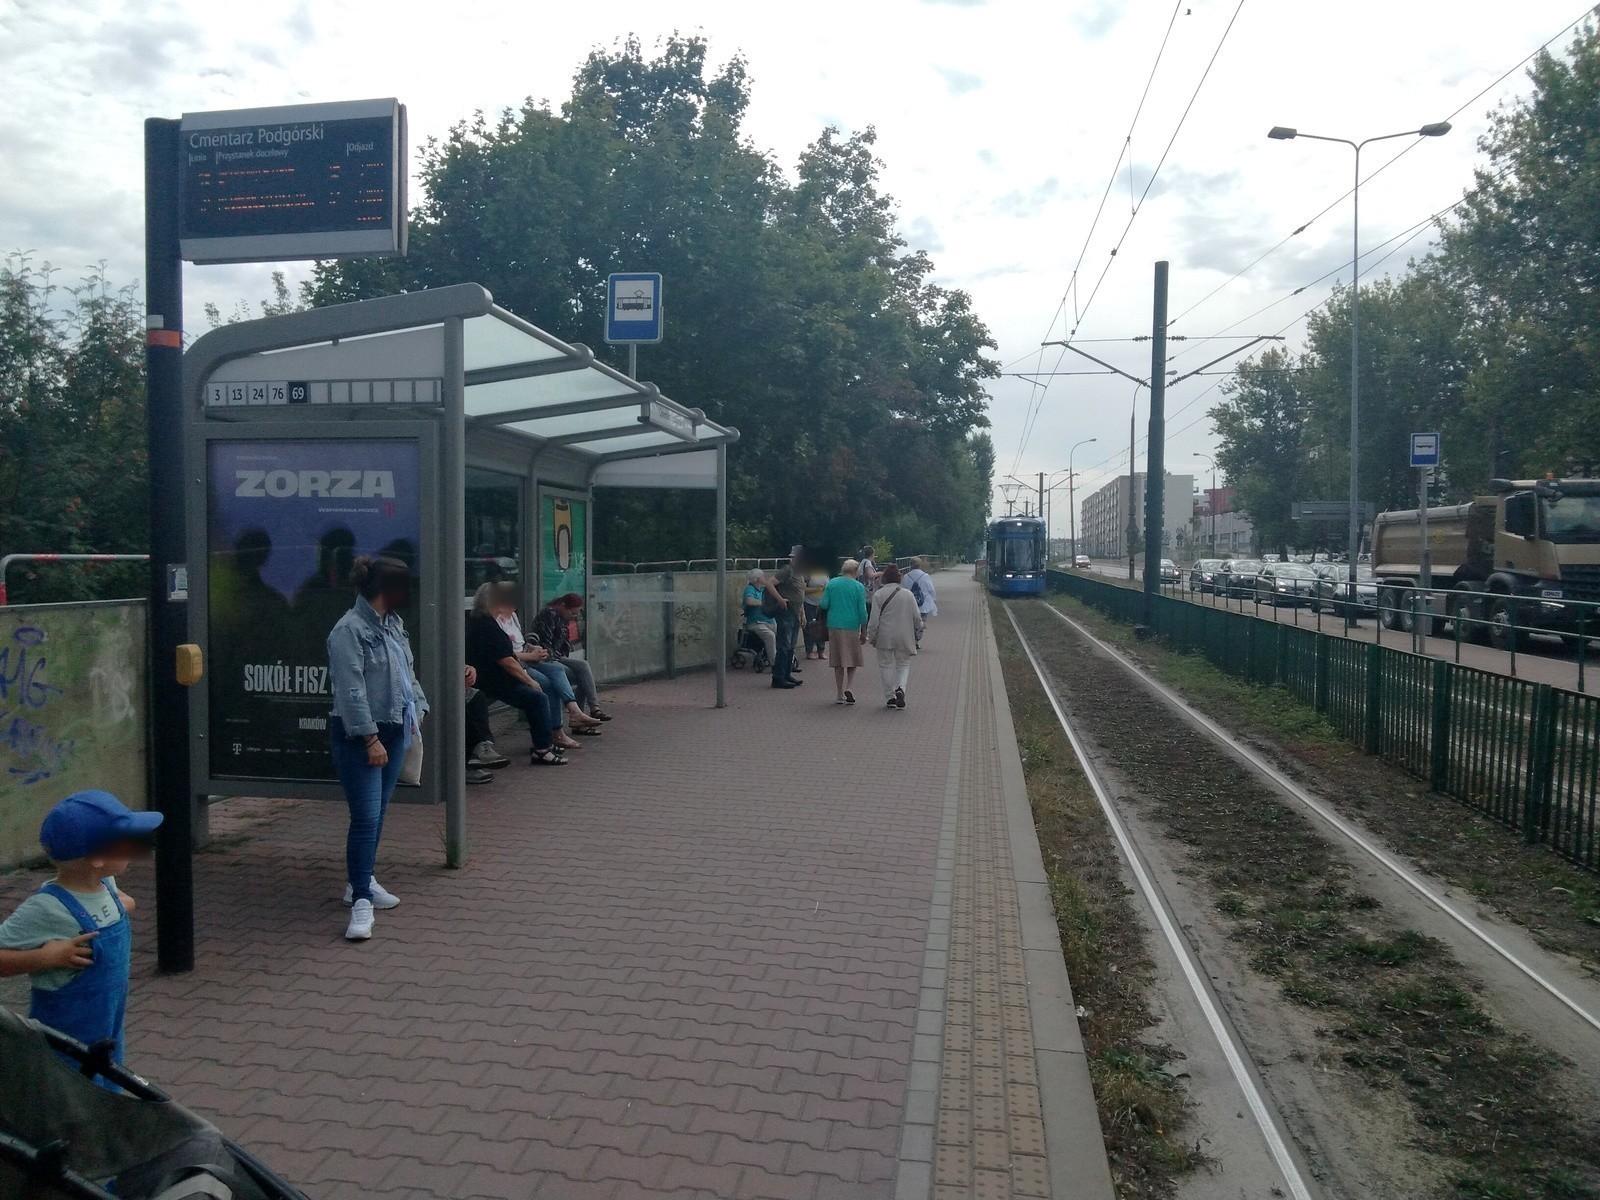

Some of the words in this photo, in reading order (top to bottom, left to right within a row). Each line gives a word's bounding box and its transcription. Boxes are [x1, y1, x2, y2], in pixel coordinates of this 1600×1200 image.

[190, 132, 254, 149] Cmentarz
[258, 123, 324, 146] Podgórski
[215, 389, 221, 401] 3
[232, 388, 243, 401] 13
[252, 388, 264, 400] 24
[272, 387, 284, 400] 76
[292, 386, 305, 400] 69
[235, 469, 396, 498] ZORZA
[244, 660, 292, 693] SOKÓŁ
[295, 665, 328, 695] FISZ
